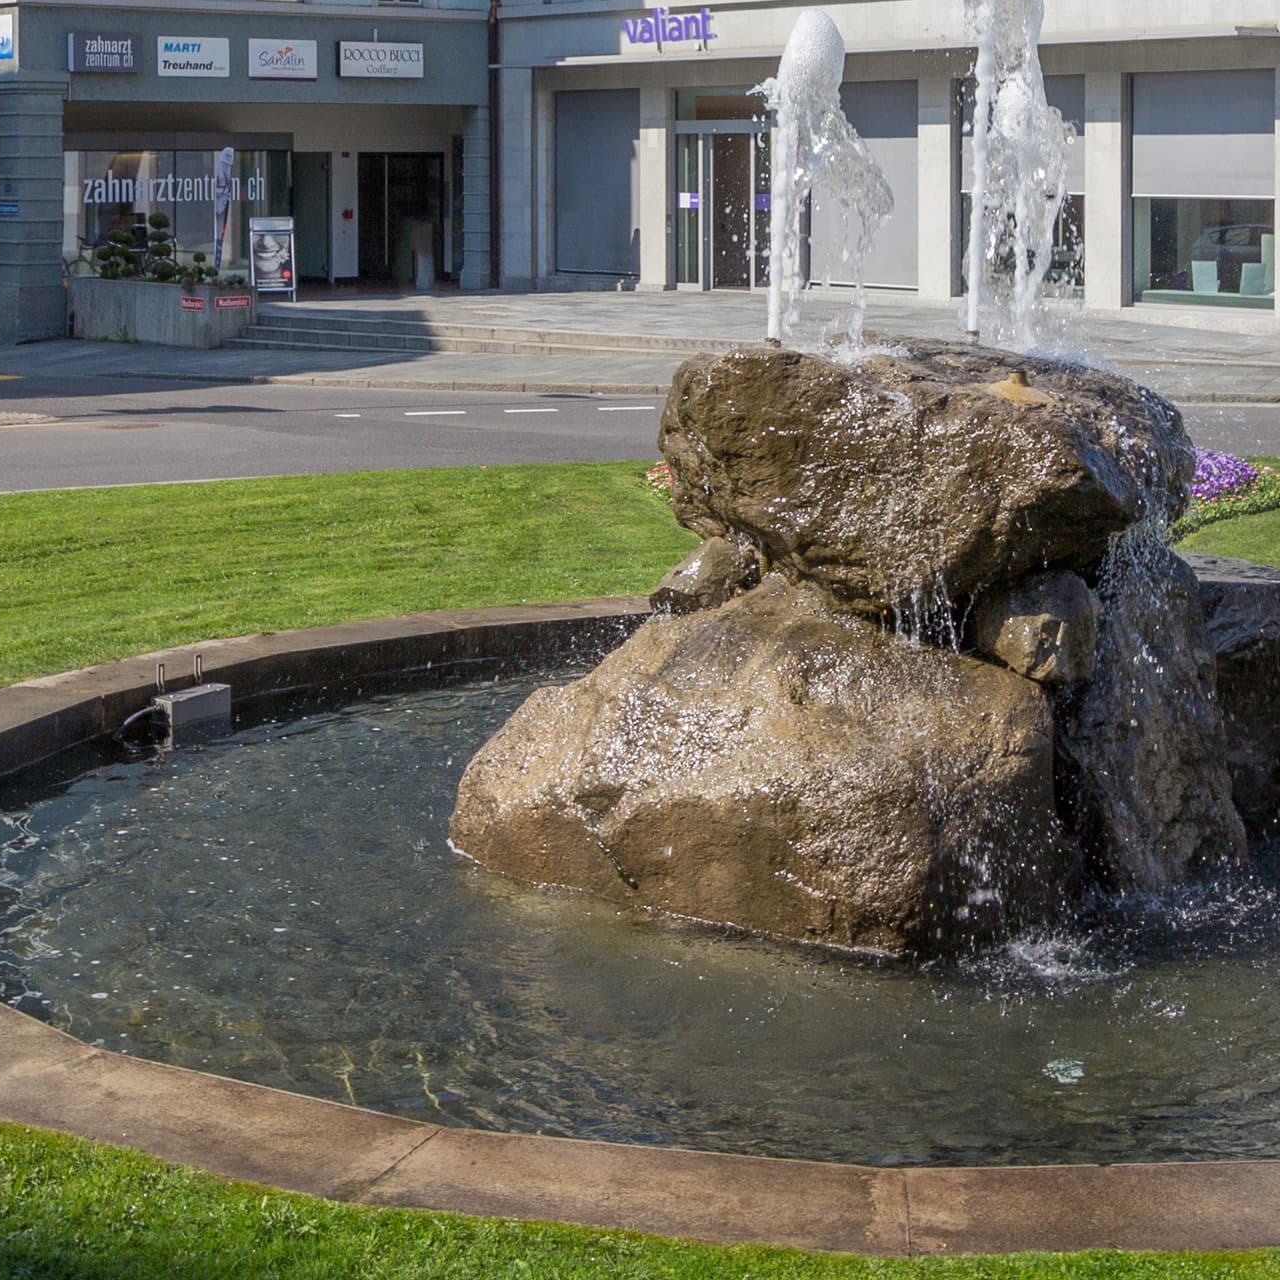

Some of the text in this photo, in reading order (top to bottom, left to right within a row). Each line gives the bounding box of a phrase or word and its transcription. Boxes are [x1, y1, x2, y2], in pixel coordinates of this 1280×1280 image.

[622, 7, 715, 44] valiant
[85, 35, 133, 54] zahnarzt
[163, 43, 201, 53] MARTI
[343, 49, 421, 63] ROCCO BUCCI
[162, 60, 213, 71] Treuhand
[83, 168, 265, 203] zahnarztzentrm.ch
